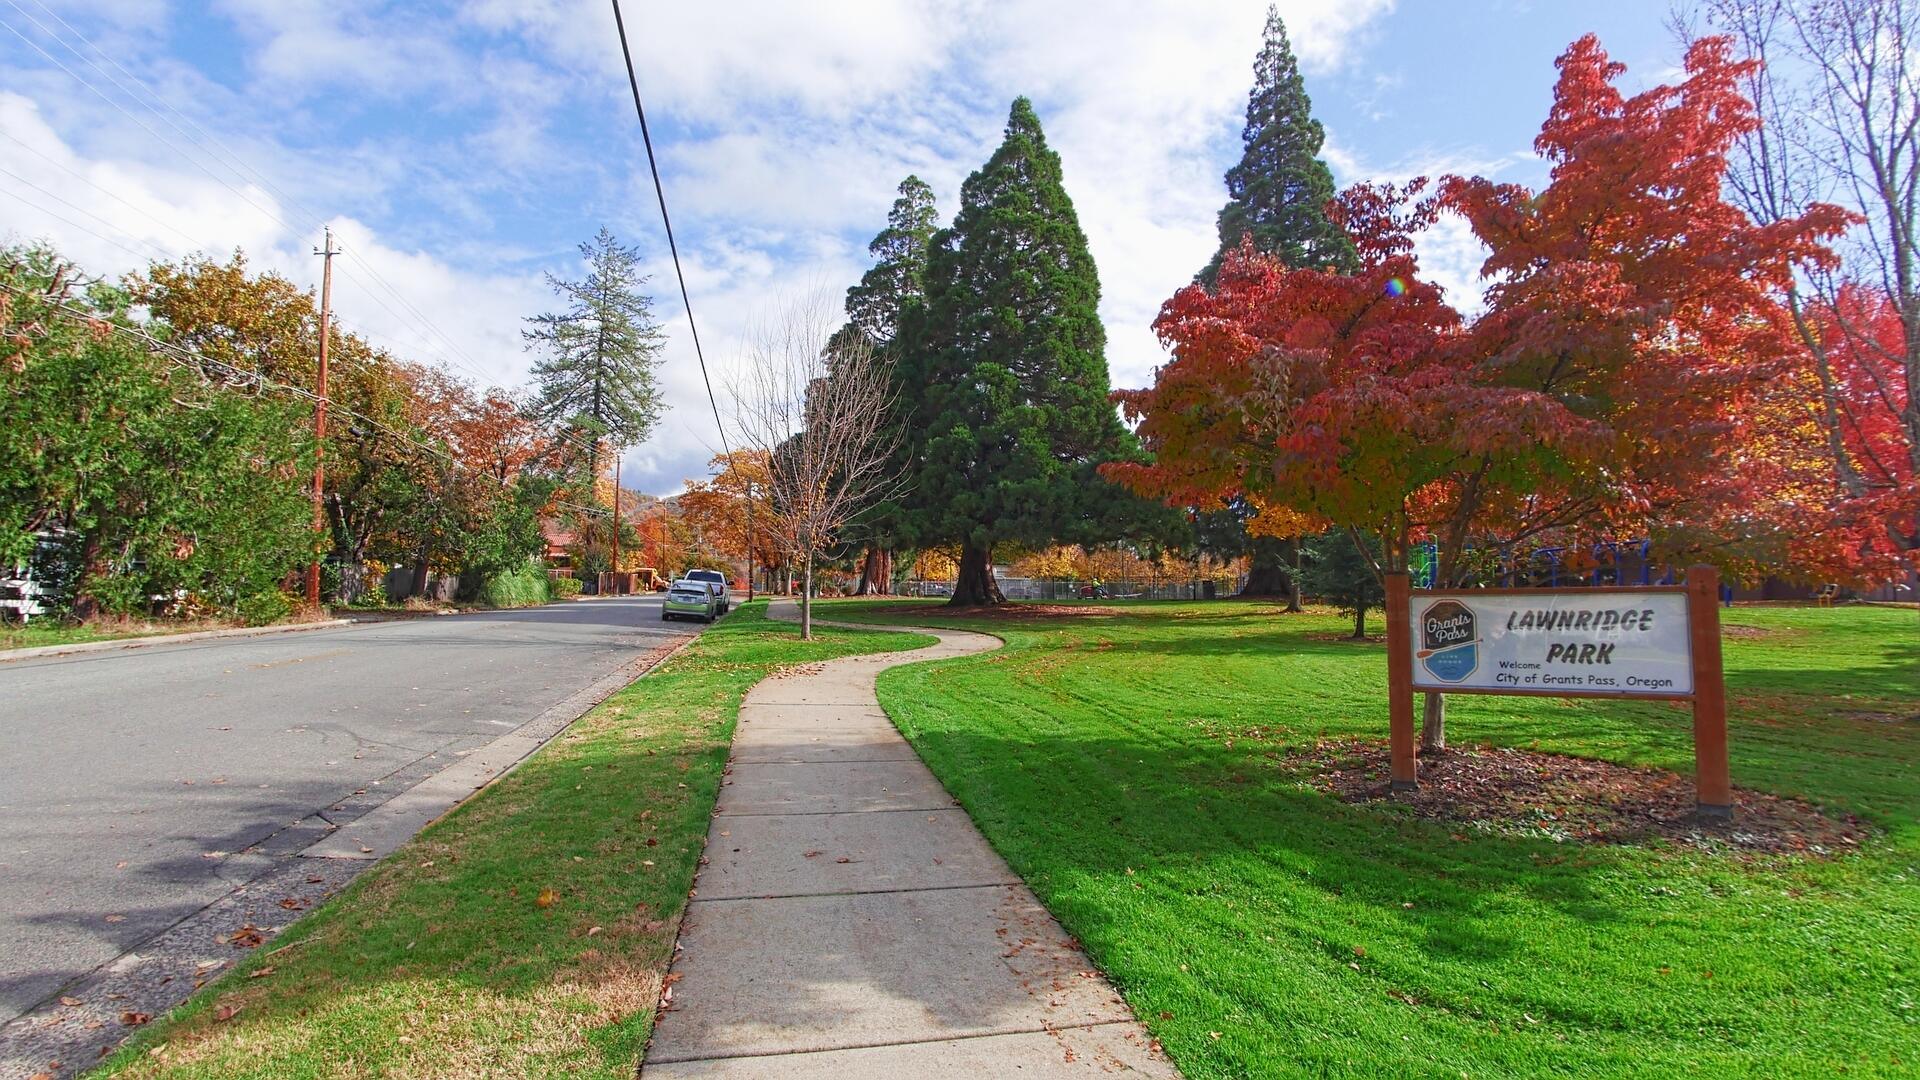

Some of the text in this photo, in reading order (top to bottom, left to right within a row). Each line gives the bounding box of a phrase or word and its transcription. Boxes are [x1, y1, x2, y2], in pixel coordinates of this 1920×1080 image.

[1427, 614, 1472, 633] Grants
[1507, 609, 1655, 632] LAWNRIDGE
[1435, 626, 1468, 642] Pass
[1546, 643, 1616, 665] PARK
[1499, 660, 1541, 670] Welcome
[1496, 673, 1519, 685] City
[1525, 673, 1537, 684] of
[1543, 673, 1583, 686] Grants
[1626, 675, 1673, 689] Oregon
